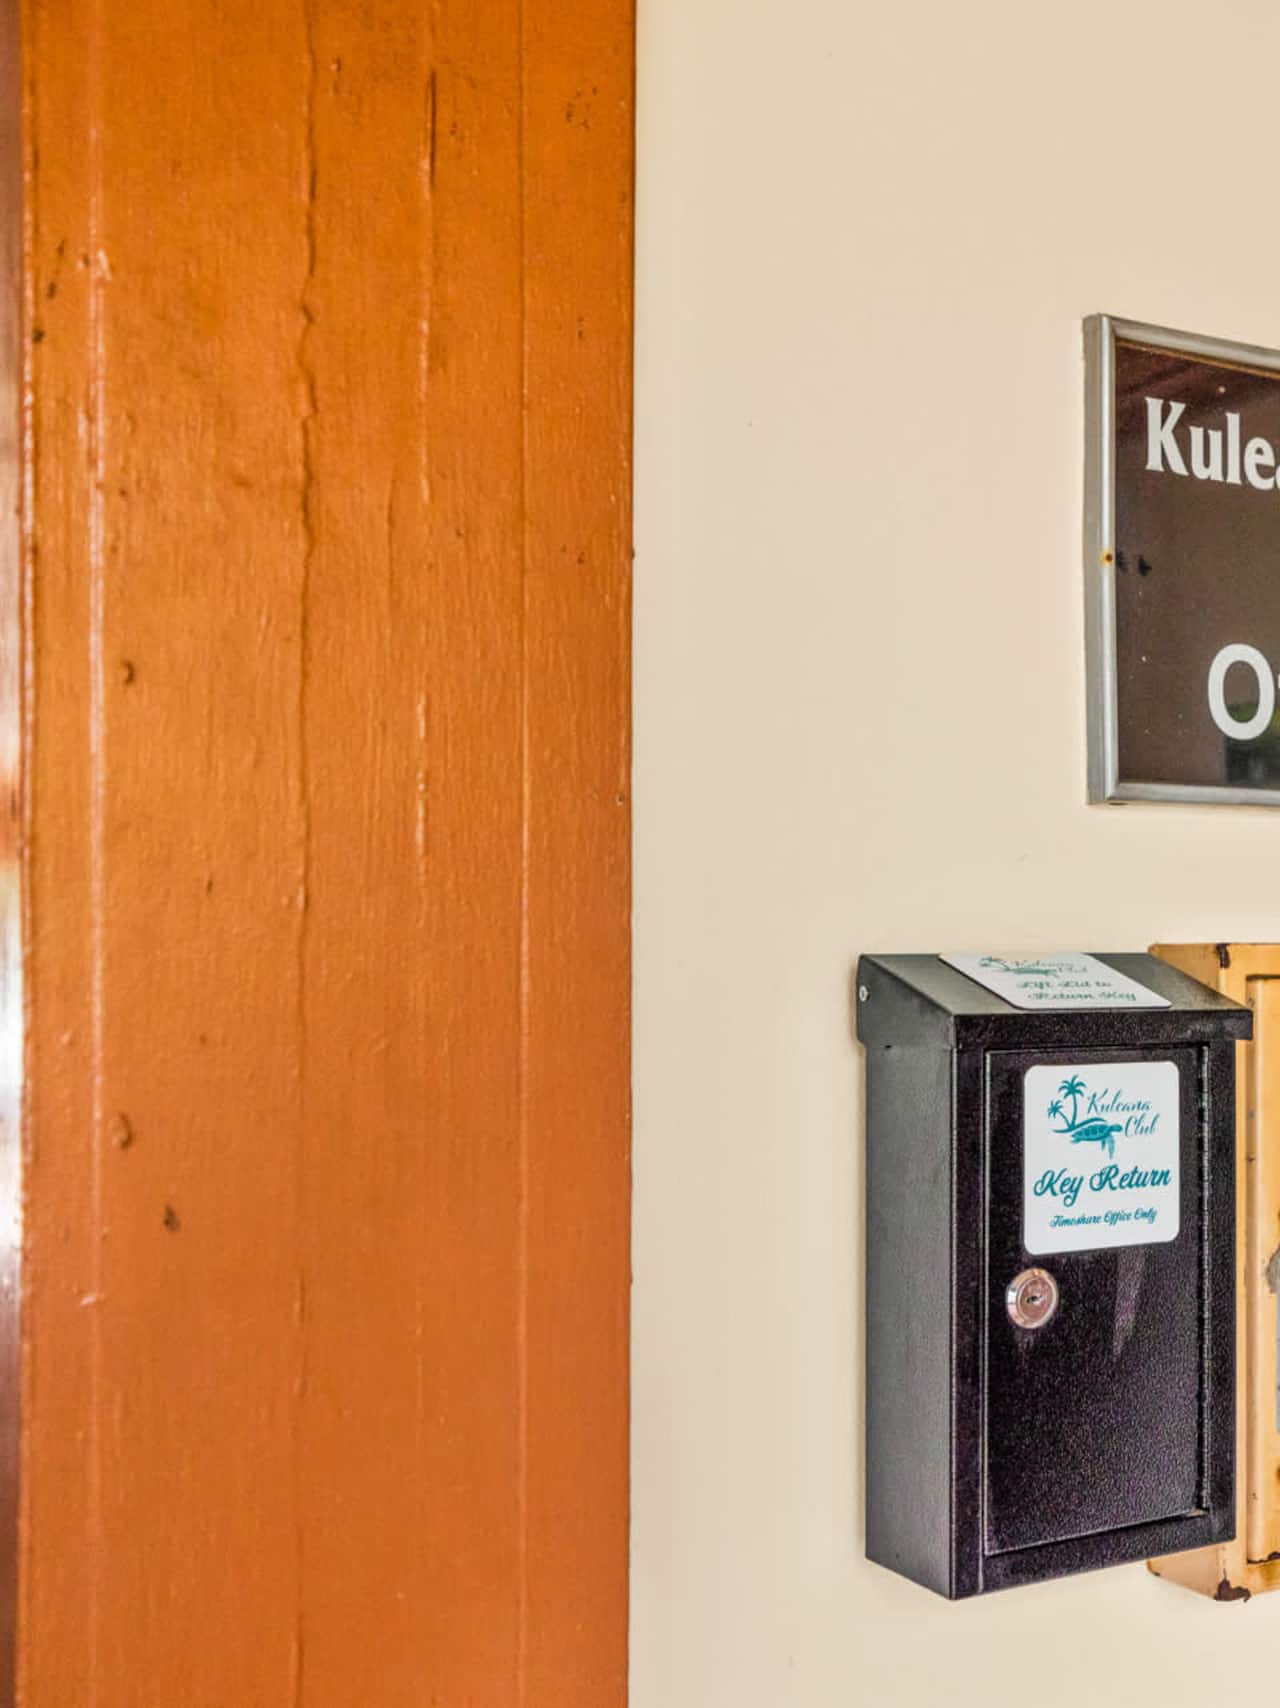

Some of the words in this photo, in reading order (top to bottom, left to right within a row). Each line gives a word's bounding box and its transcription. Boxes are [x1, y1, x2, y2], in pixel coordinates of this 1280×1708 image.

[1088, 1089, 1152, 1114] Kuleana
[1124, 1113, 1160, 1137] Club
[1033, 1168, 1084, 1207] Key
[1089, 1164, 1171, 1191] Return
[1050, 1213, 1101, 1228] Timeshare
[1104, 1209, 1132, 1226] Office
[1134, 1207, 1157, 1225] Only
